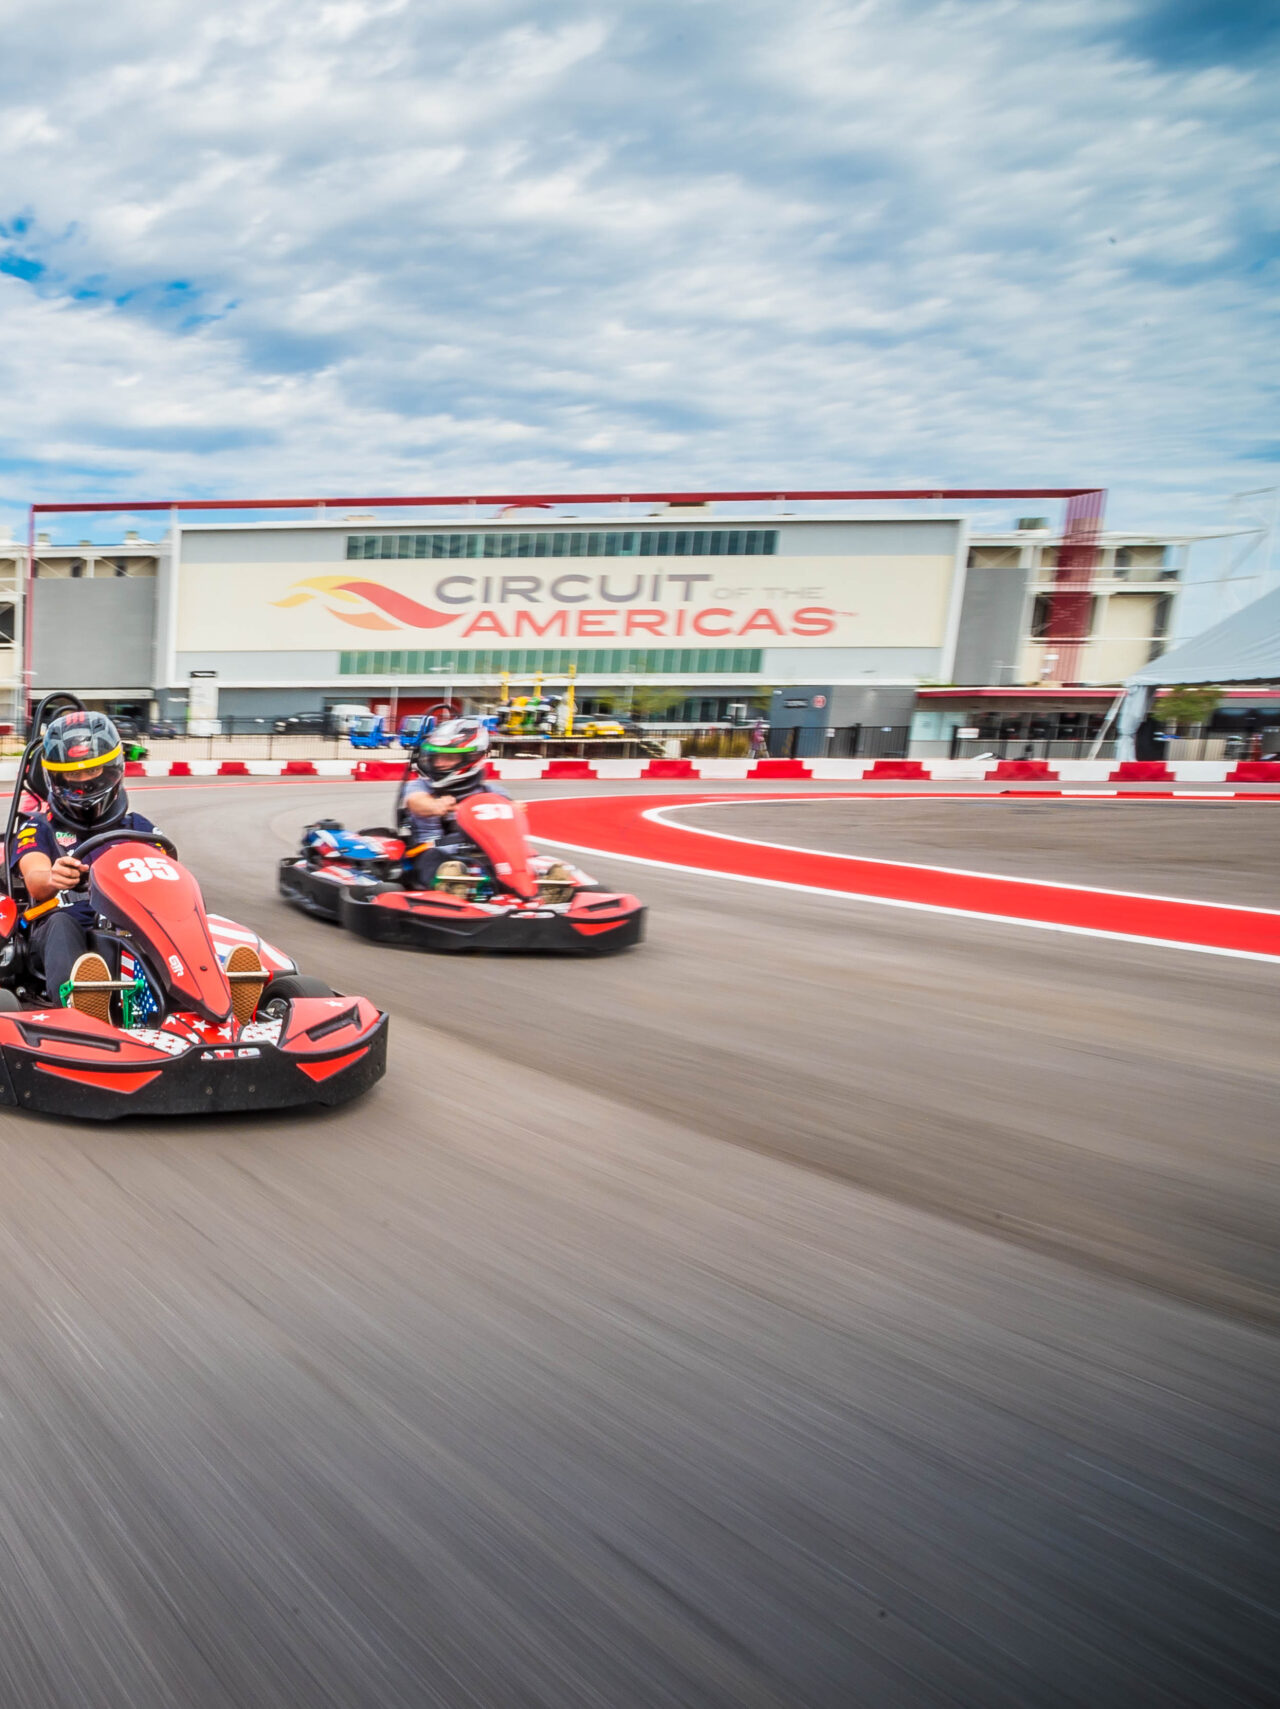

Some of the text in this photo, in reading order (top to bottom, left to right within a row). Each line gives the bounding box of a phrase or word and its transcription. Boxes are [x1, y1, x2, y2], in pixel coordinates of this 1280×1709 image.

[434, 573, 825, 604] CIRCUIT OF THE
[459, 606, 837, 638] AMERICAS
[118, 856, 180, 882] 35
